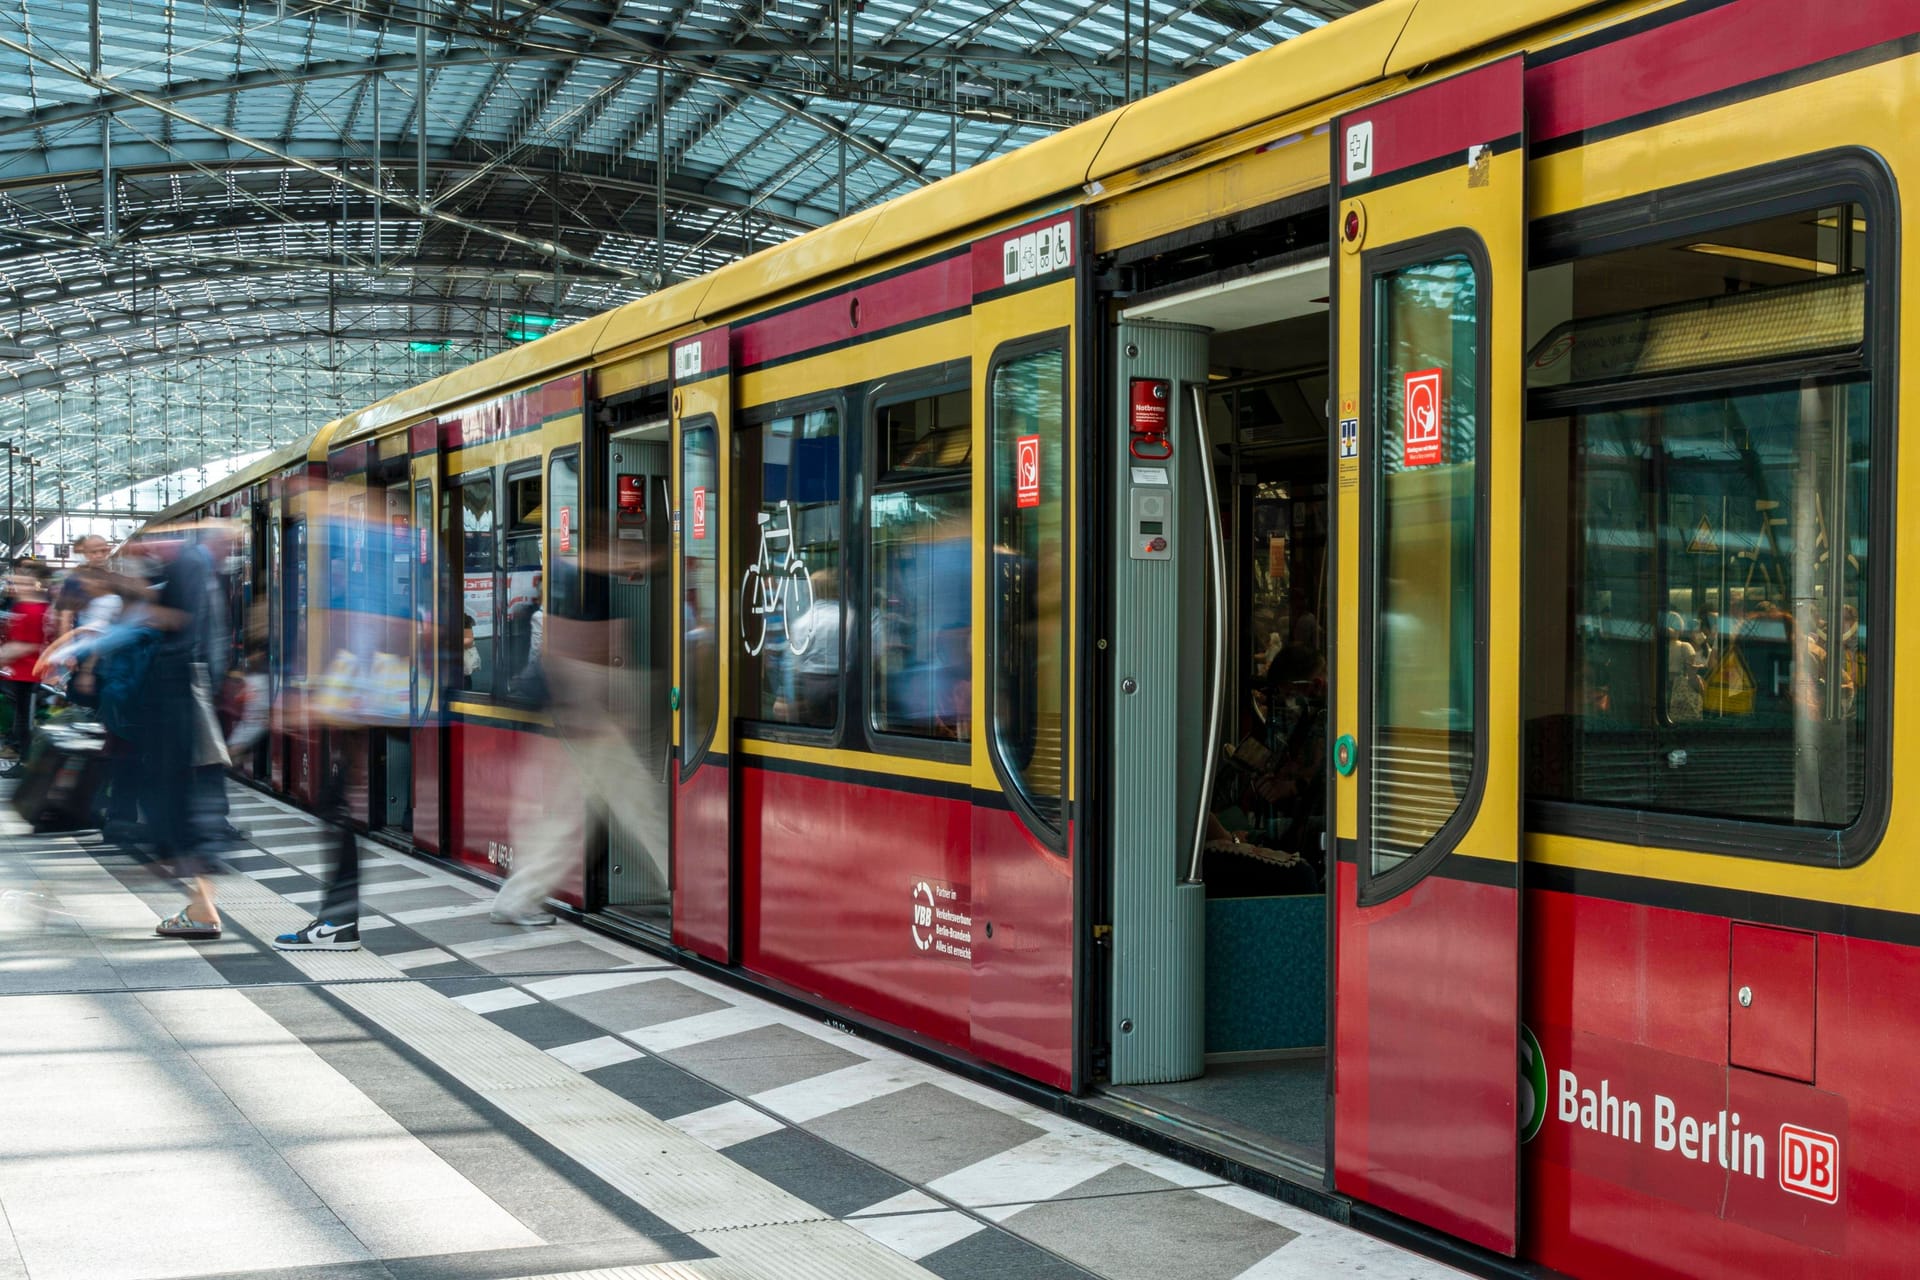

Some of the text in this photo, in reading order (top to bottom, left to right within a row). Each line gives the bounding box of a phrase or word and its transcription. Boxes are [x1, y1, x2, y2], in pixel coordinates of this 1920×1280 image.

[936, 886, 957, 900] Partner im
[914, 904, 932, 927] VBB
[936, 940, 947, 953] Alles
[1558, 1069, 1642, 1144] Bahn
[1654, 1094, 1766, 1180] Berlin
[1786, 1136, 1832, 1190] DB
